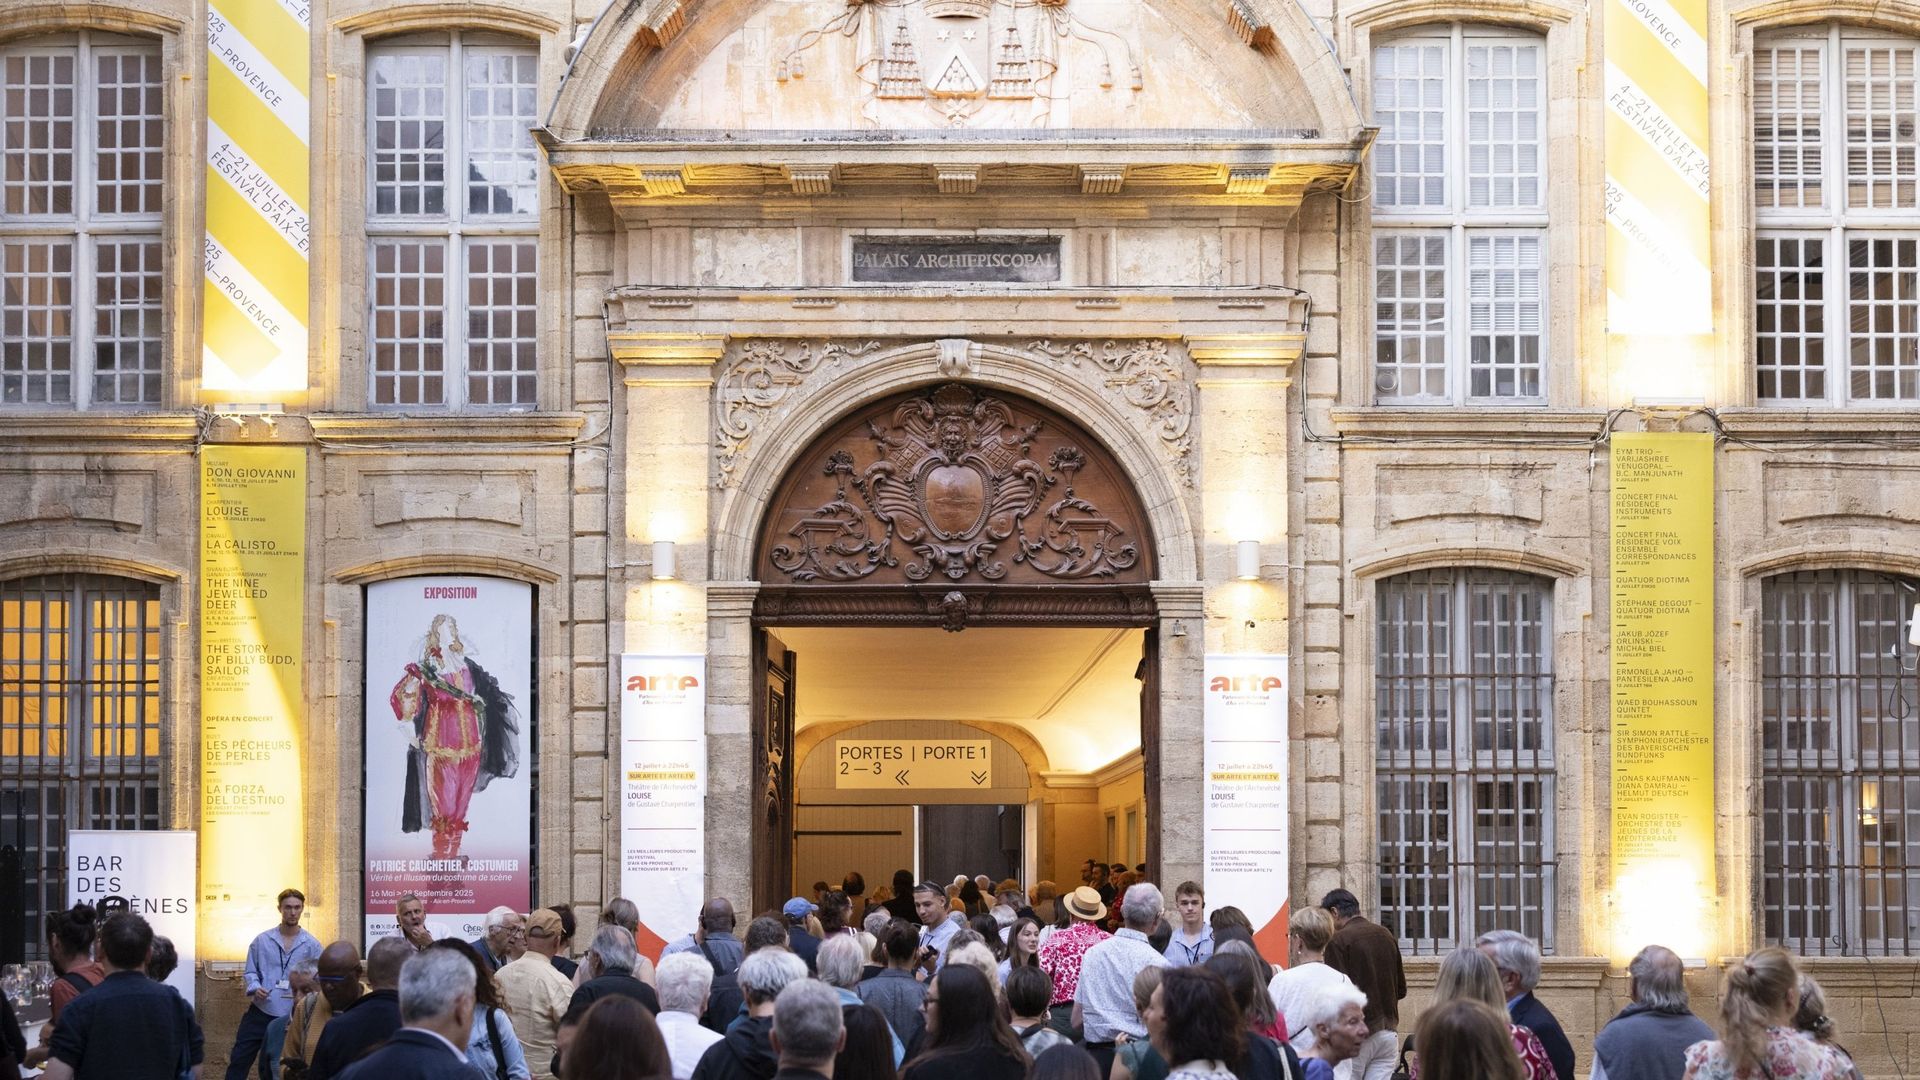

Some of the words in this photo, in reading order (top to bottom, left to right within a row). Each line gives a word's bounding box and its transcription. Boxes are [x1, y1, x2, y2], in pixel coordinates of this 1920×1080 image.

[1610, 94, 1662, 145] FESTIVAL
[1650, 116, 1696, 158] JUILLET
[1695, 158, 1710, 178] 20
[211, 152, 258, 204] FESTIVAL
[248, 170, 296, 216] JUILLET
[294, 216, 310, 237] 20
[854, 253, 908, 268] PALAIS
[915, 253, 1058, 268] ARCHIEPISCOPAL
[205, 256, 280, 336] N—PROVENCE
[206, 468, 232, 477] DON
[236, 468, 296, 479] GIOVANNI
[206, 507, 248, 516] LOUISE
[206, 540, 220, 549] LA
[224, 540, 276, 550] CALISTO
[206, 579, 229, 588] THE
[232, 579, 259, 588] NINE
[206, 589, 268, 598] JEWELLED
[424, 587, 477, 599] EXPOSITION
[206, 600, 237, 609] DEER
[206, 644, 229, 654] THE
[234, 644, 268, 654] STORY
[206, 655, 221, 665] OF
[227, 656, 255, 664] BILLY
[260, 656, 296, 666] BUDD,
[206, 666, 249, 675] SAILOR
[627, 673, 698, 691] arte
[1210, 674, 1282, 692] arte
[206, 741, 228, 750] LES
[232, 739, 292, 750] PÊCHEURS
[206, 752, 221, 760] DE
[226, 752, 271, 760] PERLES
[841, 746, 902, 760] PORTES
[923, 746, 975, 760] PORTE
[980, 746, 986, 759] 1
[206, 785, 220, 794] LA
[225, 785, 265, 794] FORZA
[206, 796, 227, 804] DEL
[233, 796, 285, 805] DESTINO
[78, 856, 122, 871] BAR
[370, 860, 406, 872] PATRICE
[410, 860, 465, 872] CAUCHETIER,
[468, 860, 519, 871] COSTUMIER
[78, 877, 121, 892] DES
[78, 895, 188, 914] ÈNES
